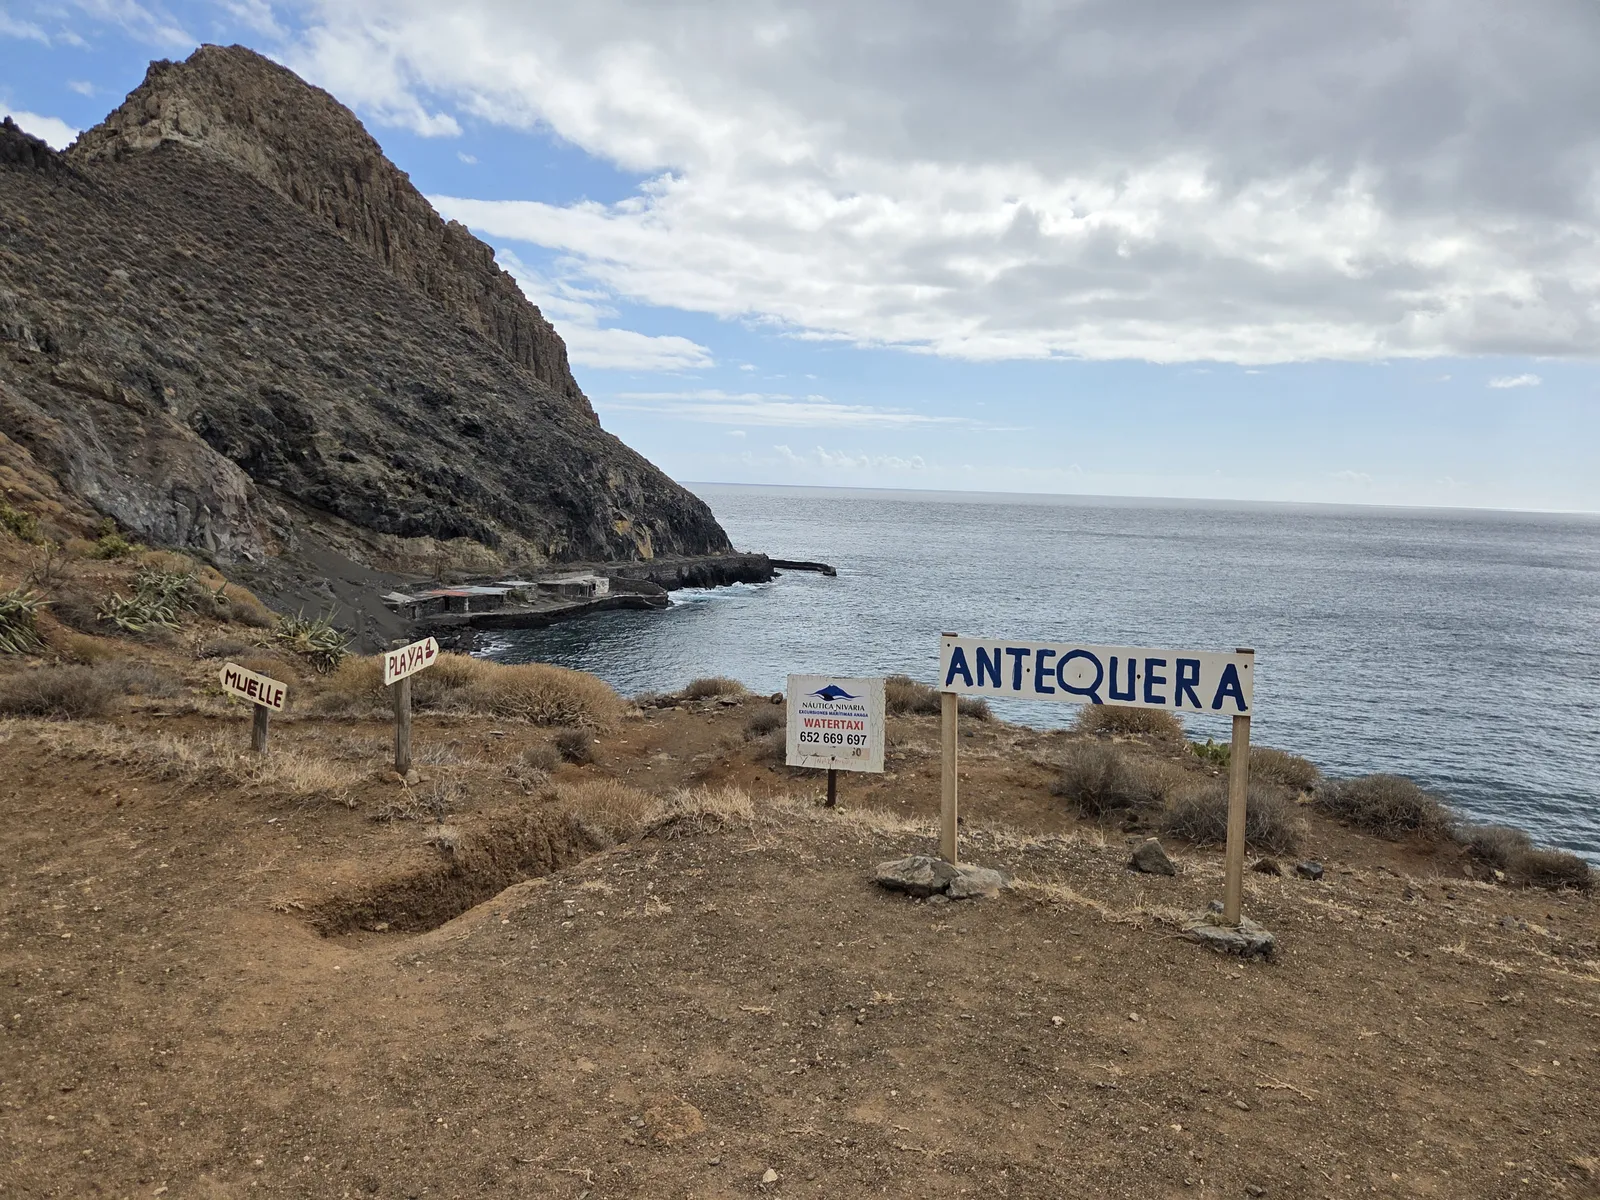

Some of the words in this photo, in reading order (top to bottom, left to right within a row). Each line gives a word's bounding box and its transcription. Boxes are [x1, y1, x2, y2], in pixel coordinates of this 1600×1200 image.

[389, 645, 424, 678] PLAYA
[224, 669, 283, 708] MUELLE
[946, 646, 1248, 711] ANTEQUERA
[802, 701, 834, 710] NÁUTICA
[804, 718, 864, 730] WATERTAXI
[800, 731, 820, 743] 652
[823, 732, 843, 744] 669
[847, 734, 867, 746] 697
